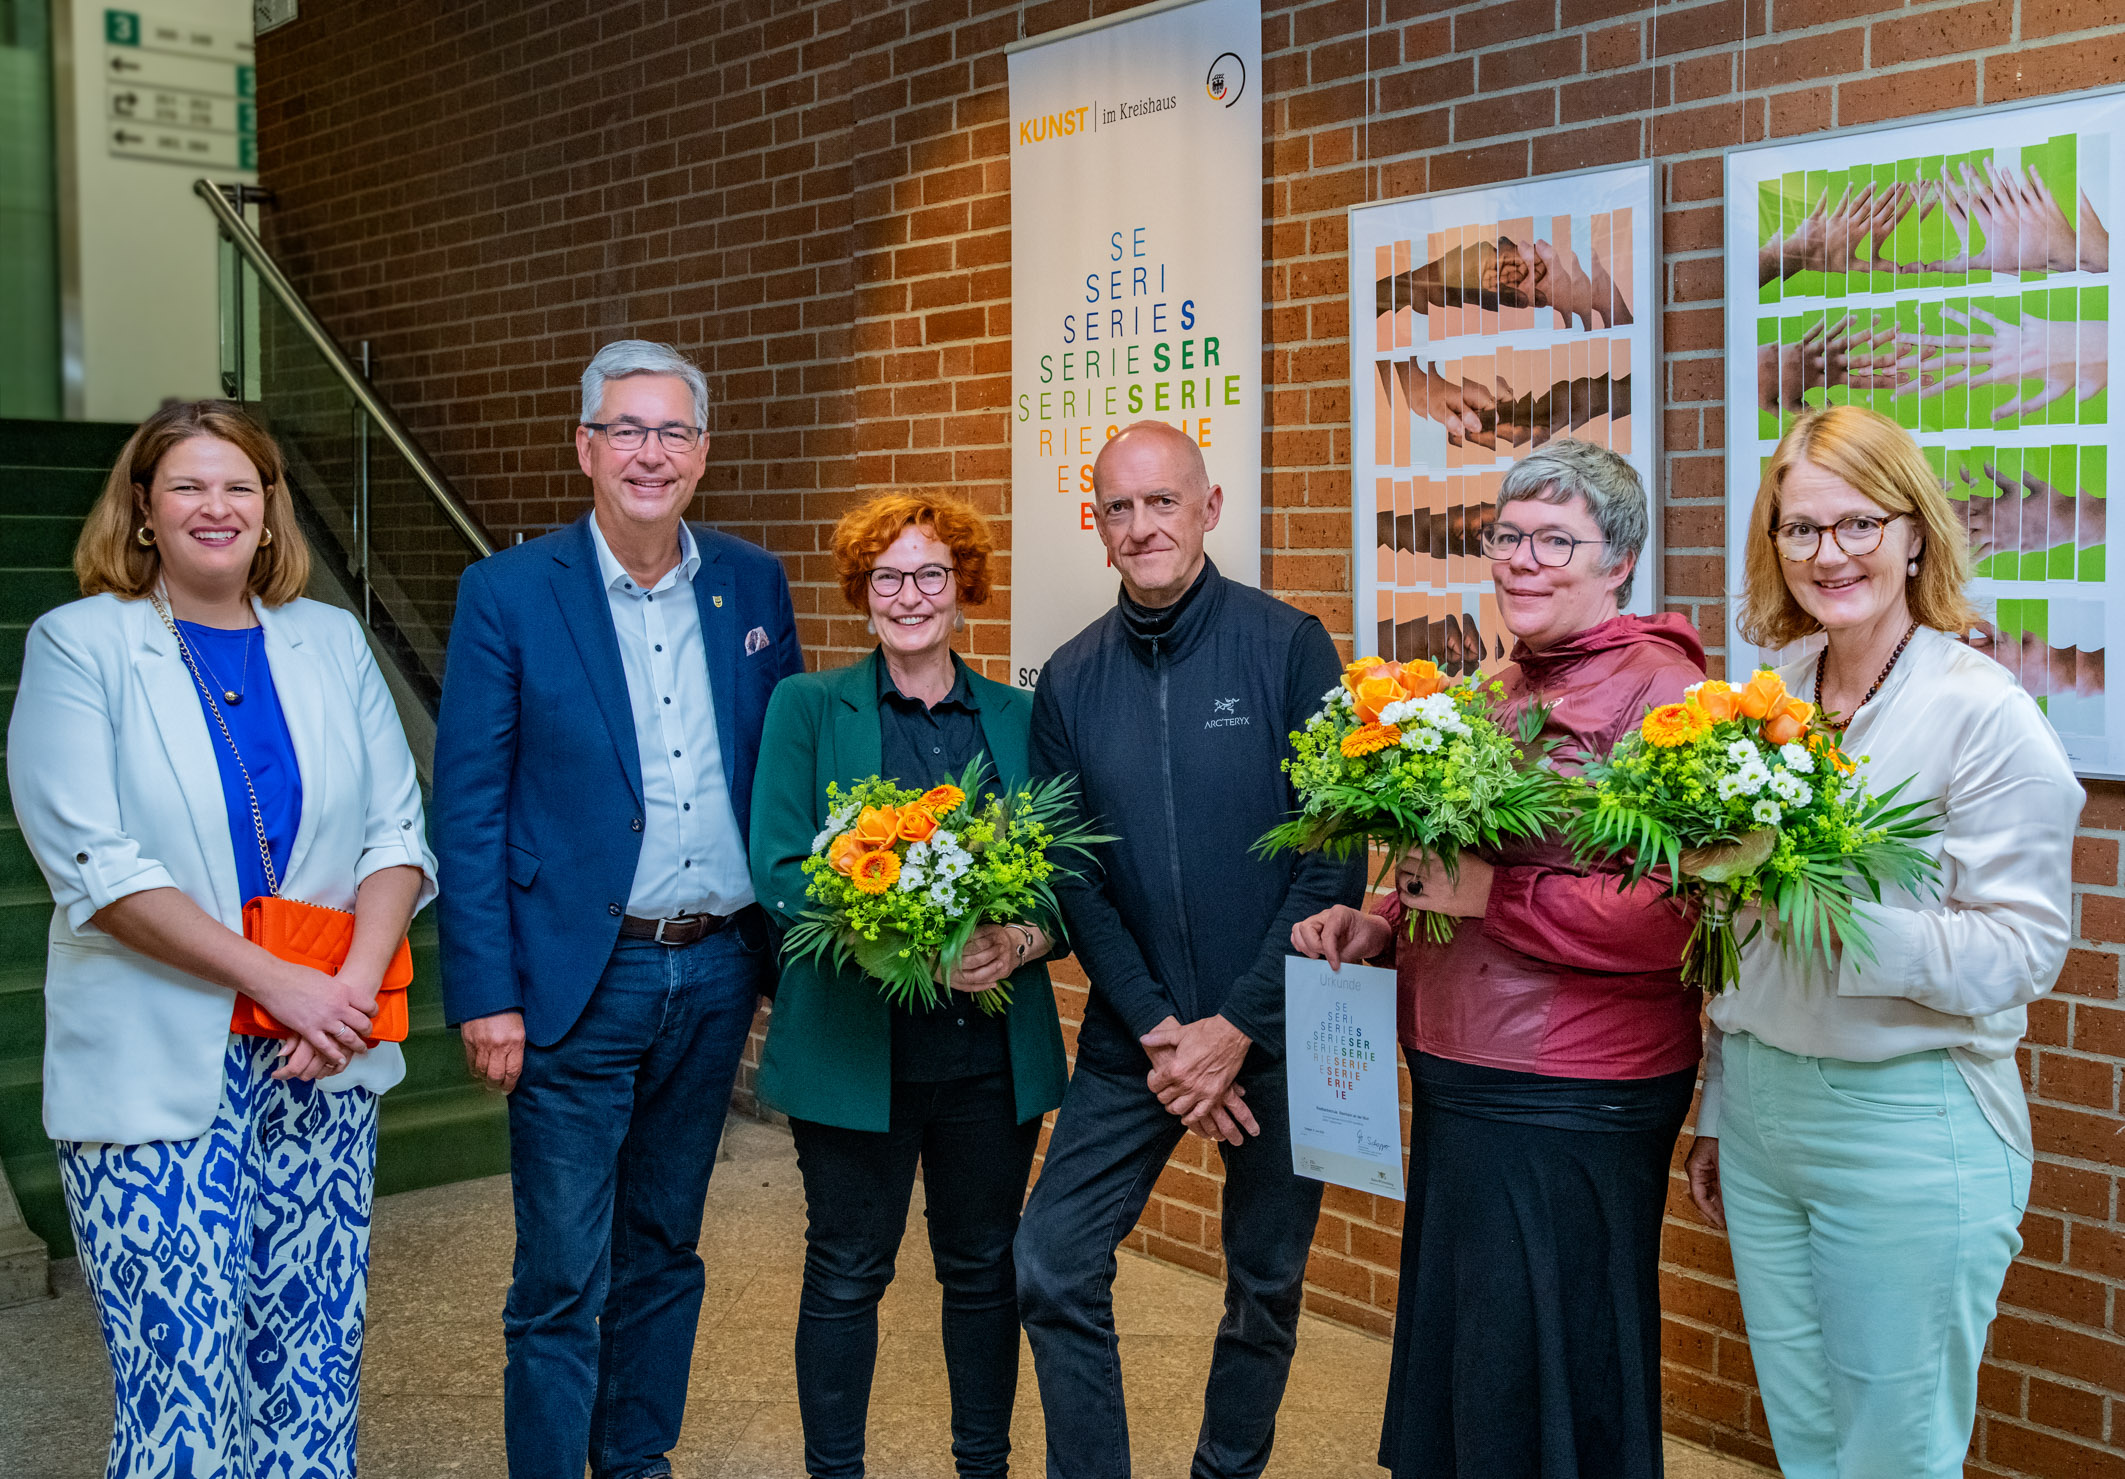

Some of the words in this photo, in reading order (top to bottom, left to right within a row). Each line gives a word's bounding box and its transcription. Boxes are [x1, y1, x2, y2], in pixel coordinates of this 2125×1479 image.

[114, 15, 132, 41] 3
[1102, 109, 1116, 125] im
[1120, 95, 1177, 121] Kreishaus
[1019, 106, 1089, 146] KUNST
[1111, 227, 1146, 261] SE
[1086, 264, 1165, 303] SERI
[1320, 973, 1362, 992] Urkunde
[1328, 1011, 1353, 1024] SERI
[1335, 1001, 1348, 1013] SE
[1328, 1077, 1353, 1091] ERIE
[1336, 1090, 1347, 1100] IE
